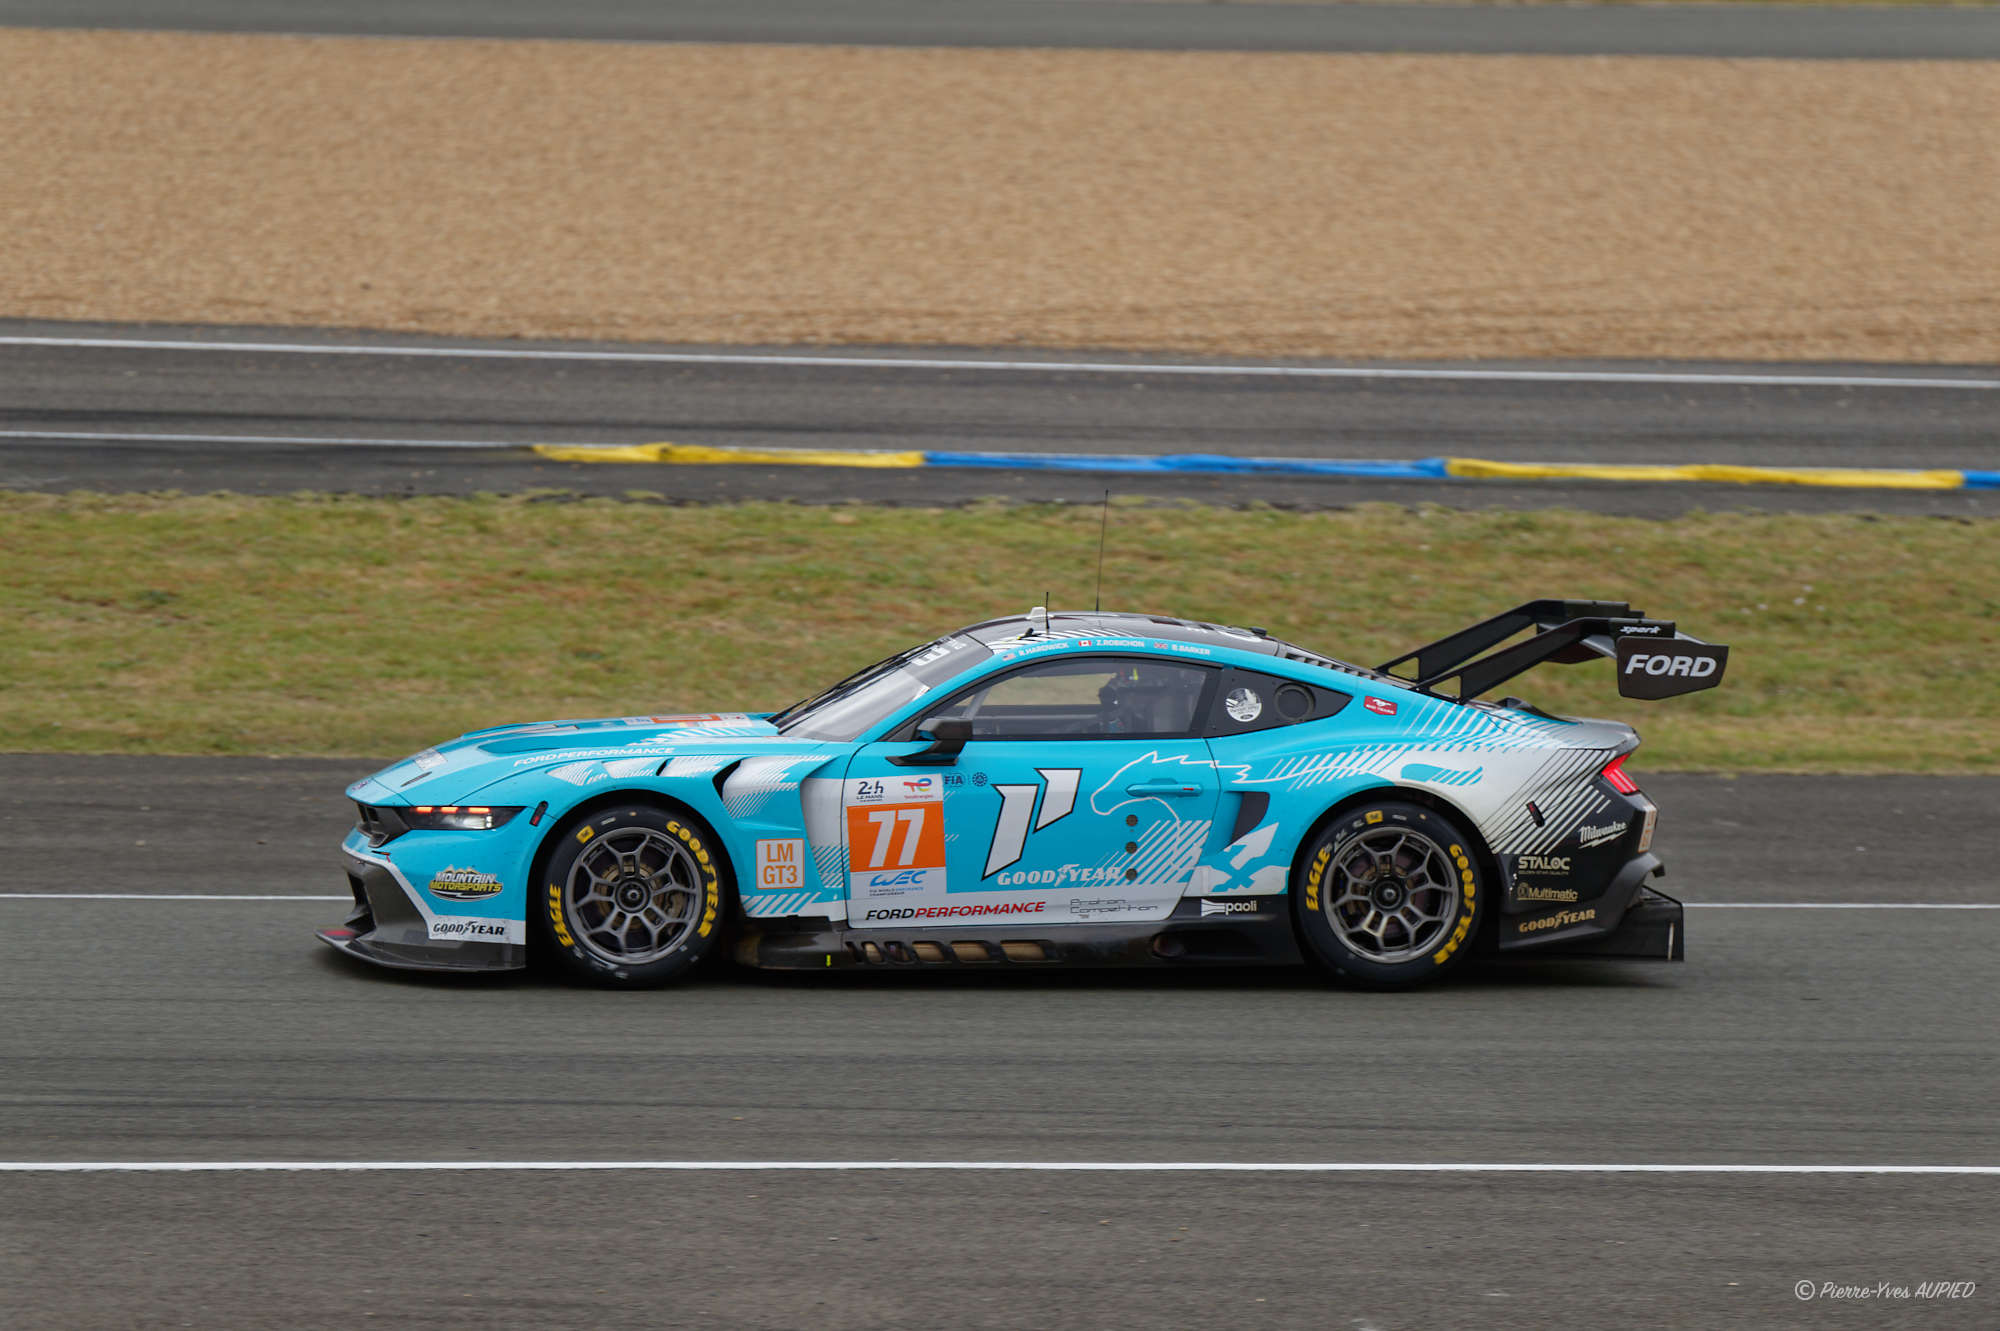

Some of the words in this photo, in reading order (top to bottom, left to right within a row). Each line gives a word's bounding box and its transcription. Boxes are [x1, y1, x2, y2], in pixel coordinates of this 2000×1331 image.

[1624, 653, 1718, 678] FORD
[944, 775, 964, 785] FIA
[868, 807, 925, 868] 77
[1578, 821, 1628, 843] Milwaukee
[767, 843, 793, 863] LM
[1518, 856, 1571, 870] STALOC
[436, 871, 498, 884] MOUNTAIN
[763, 865, 798, 885] GT3
[869, 870, 928, 887] WEC
[997, 863, 1121, 887] GOODYEAR
[1305, 848, 1331, 911] EAGLE
[429, 880, 502, 892] MOTORSPORTS
[1528, 887, 1578, 900] Multimatic
[549, 883, 575, 947] EAGLE
[1225, 900, 1258, 914] paoli
[432, 921, 505, 936] GOODYEAR
[1519, 909, 1597, 933] GOODYEAR
